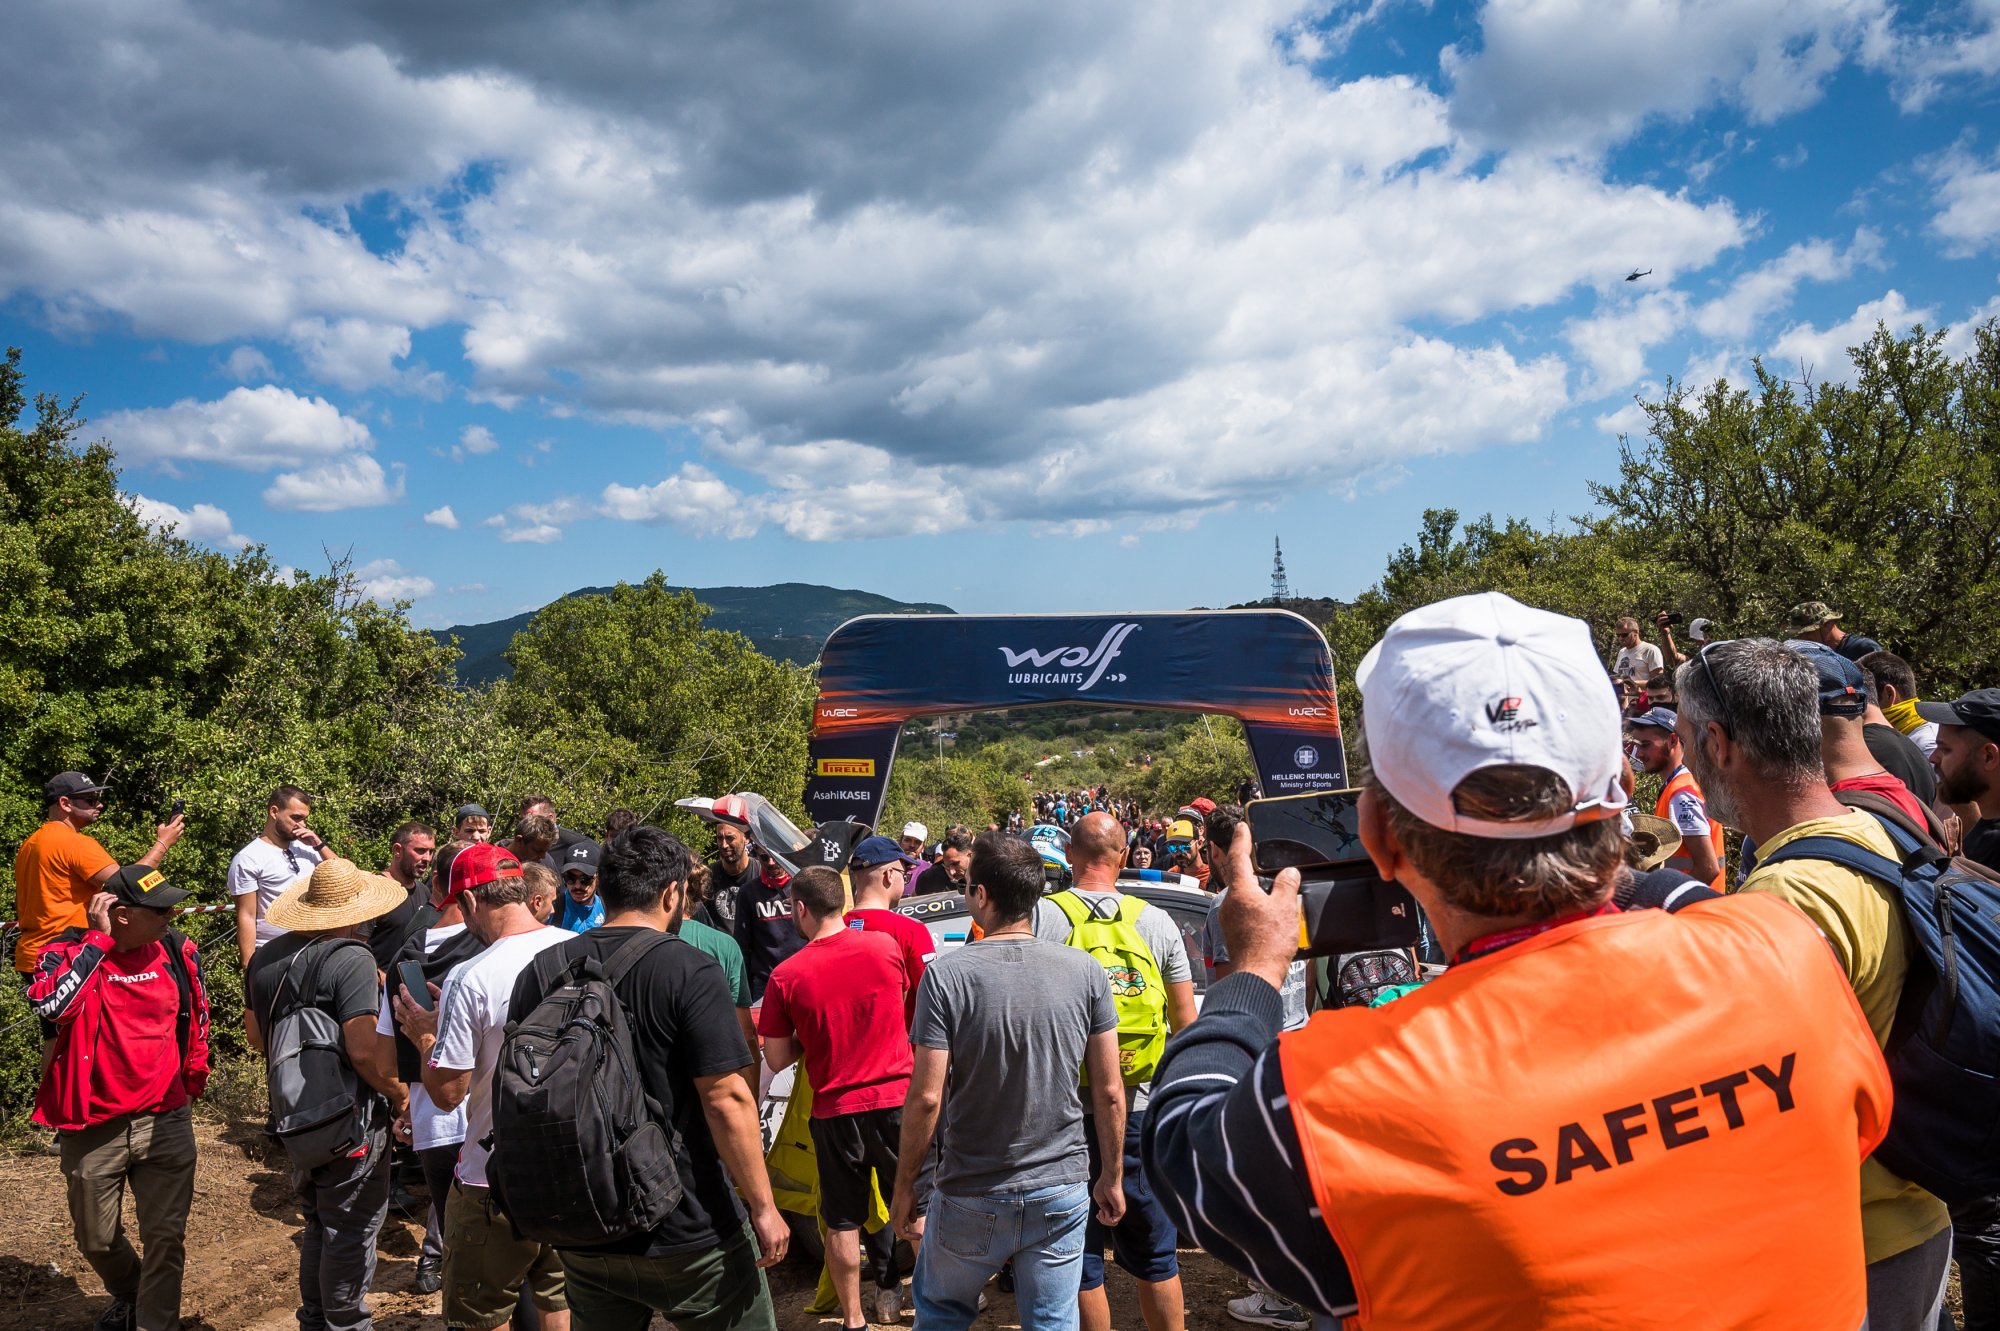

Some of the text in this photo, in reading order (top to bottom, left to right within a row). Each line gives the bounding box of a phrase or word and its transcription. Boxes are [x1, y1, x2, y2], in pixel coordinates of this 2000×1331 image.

[1008, 673, 1083, 684] LUBRICANTS
[821, 708, 858, 717] WRC
[1288, 707, 1327, 716] WRC
[822, 761, 870, 774] PIRELLI
[1033, 826, 1058, 838] 75
[107, 971, 159, 984] HONDA
[1489, 1051, 1797, 1197] SAFETY
